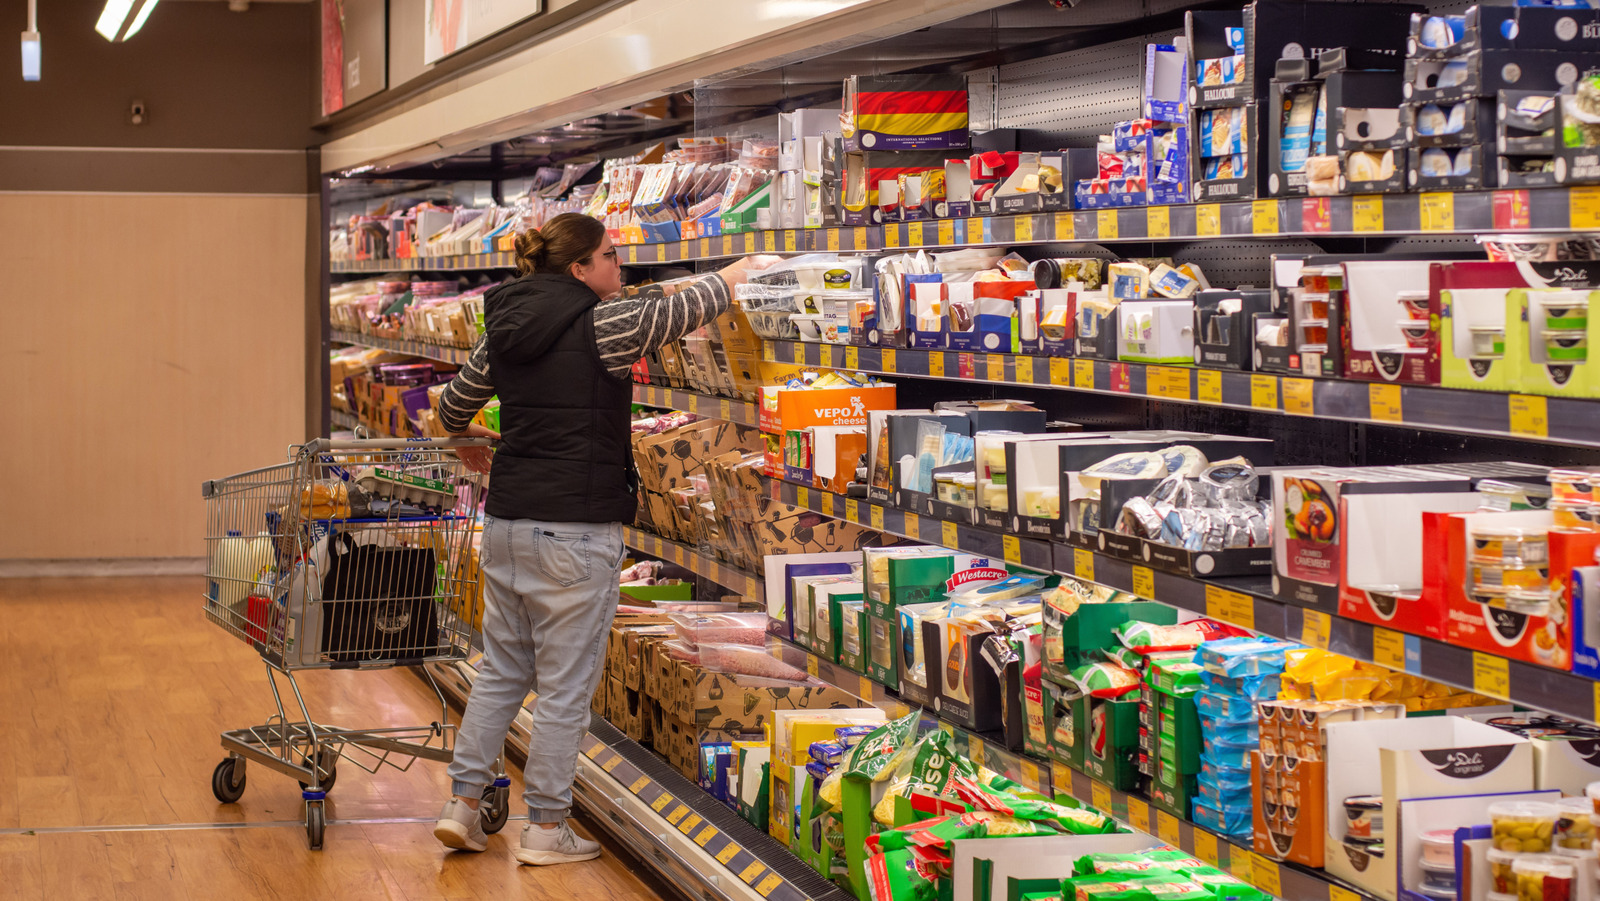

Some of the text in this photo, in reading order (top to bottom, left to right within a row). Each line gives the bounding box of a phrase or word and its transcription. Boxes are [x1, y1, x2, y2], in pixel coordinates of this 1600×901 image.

[1204, 87, 1235, 101] HALLOUMI
[1208, 182, 1238, 196] HALLOUMI
[773, 373, 796, 384] Farm
[814, 408, 851, 418] VEPO
[833, 417, 866, 425] cheese
[1294, 556, 1331, 569] CAMEMBERT
[958, 569, 1002, 583] Westacre
